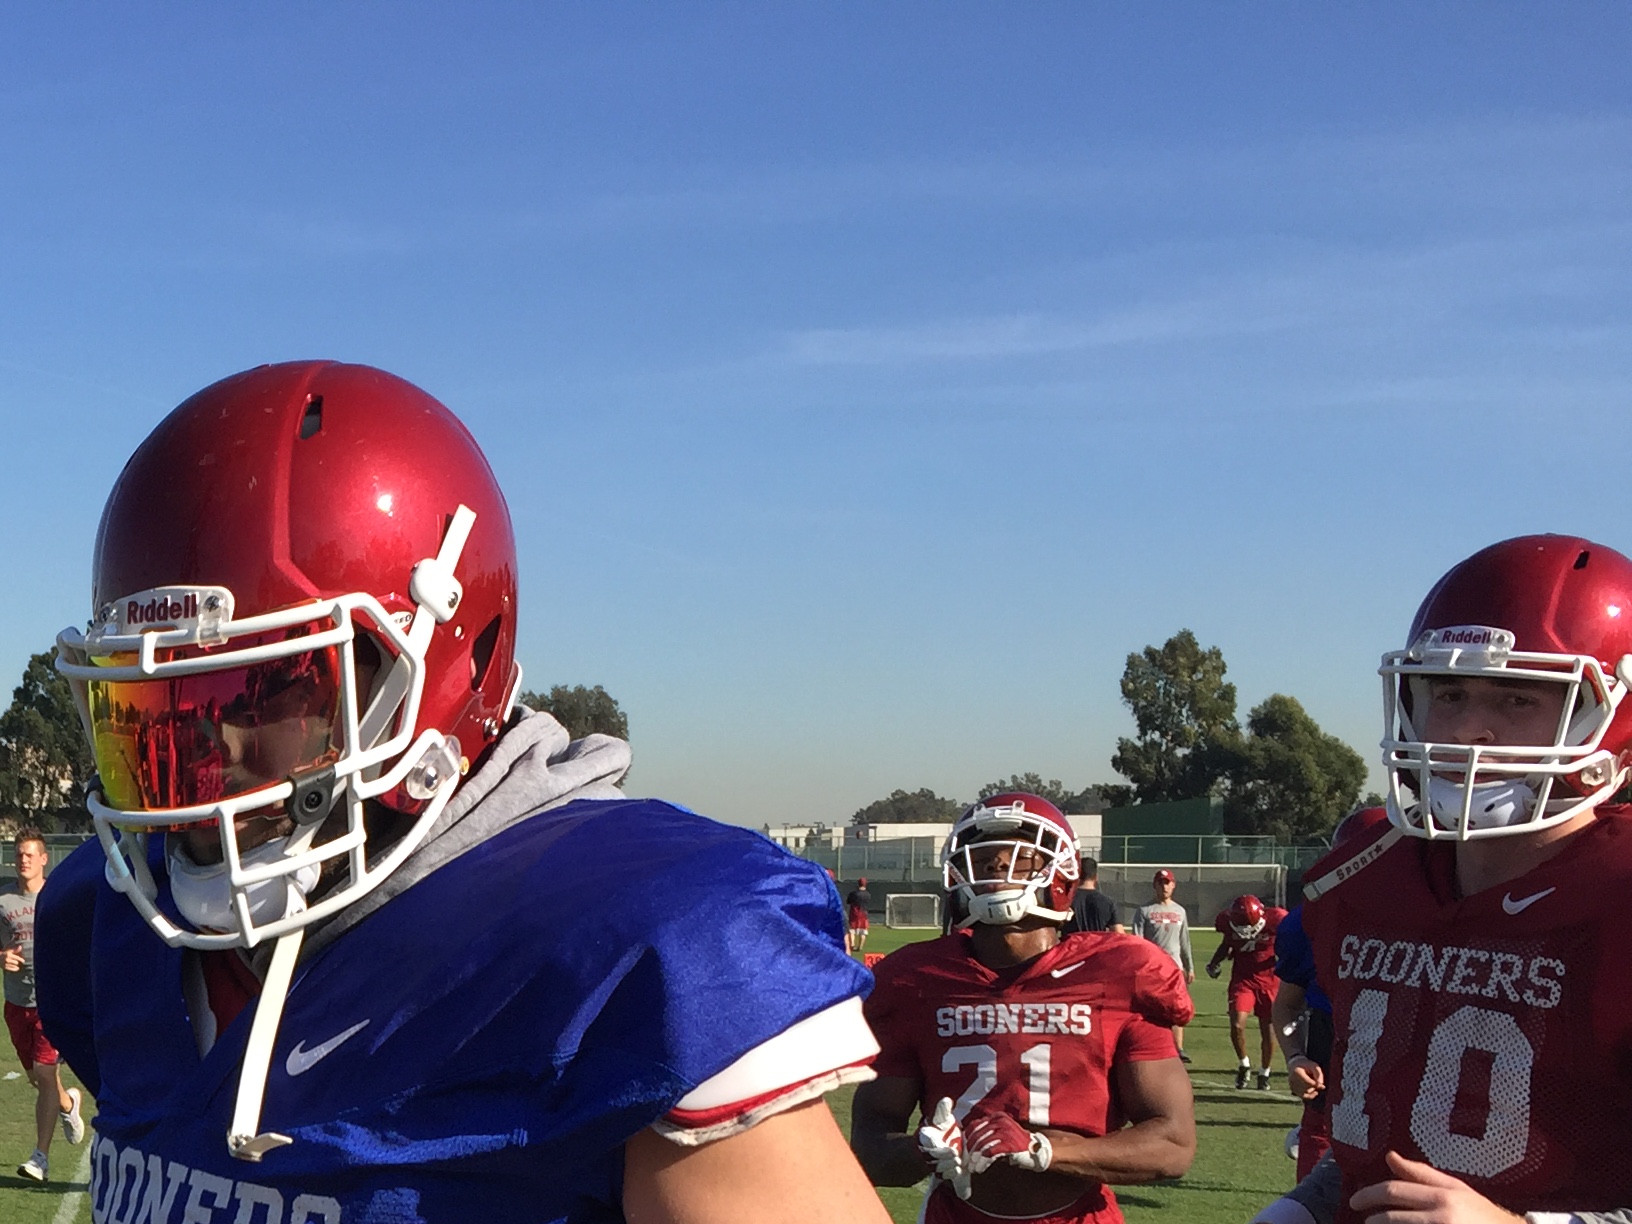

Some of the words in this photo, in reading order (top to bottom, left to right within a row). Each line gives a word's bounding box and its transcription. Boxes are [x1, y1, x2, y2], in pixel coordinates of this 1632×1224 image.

[127, 593, 198, 625] Riddell
[1441, 629, 1492, 644] Riddell
[1337, 934, 1566, 1009] SOONERS
[936, 1003, 1093, 1038] SOONERS
[941, 1043, 1051, 1127] 21
[1331, 987, 1535, 1179] 10
